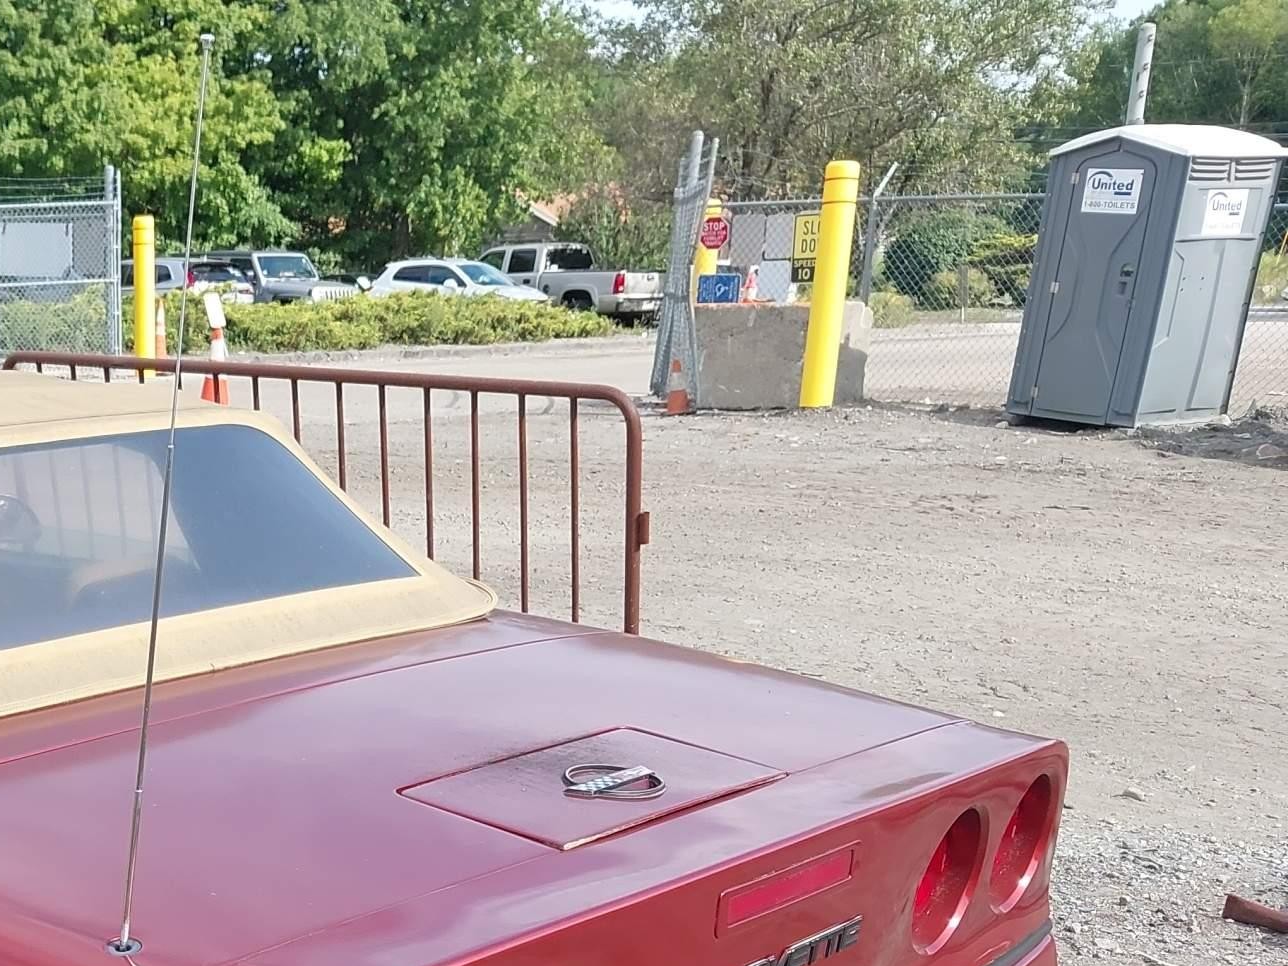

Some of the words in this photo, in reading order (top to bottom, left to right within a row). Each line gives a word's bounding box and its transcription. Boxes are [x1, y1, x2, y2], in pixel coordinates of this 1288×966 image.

[1091, 177, 1134, 190] United
[1212, 199, 1242, 211] United
[703, 221, 725, 231] STOP
[798, 268, 810, 280] 10
